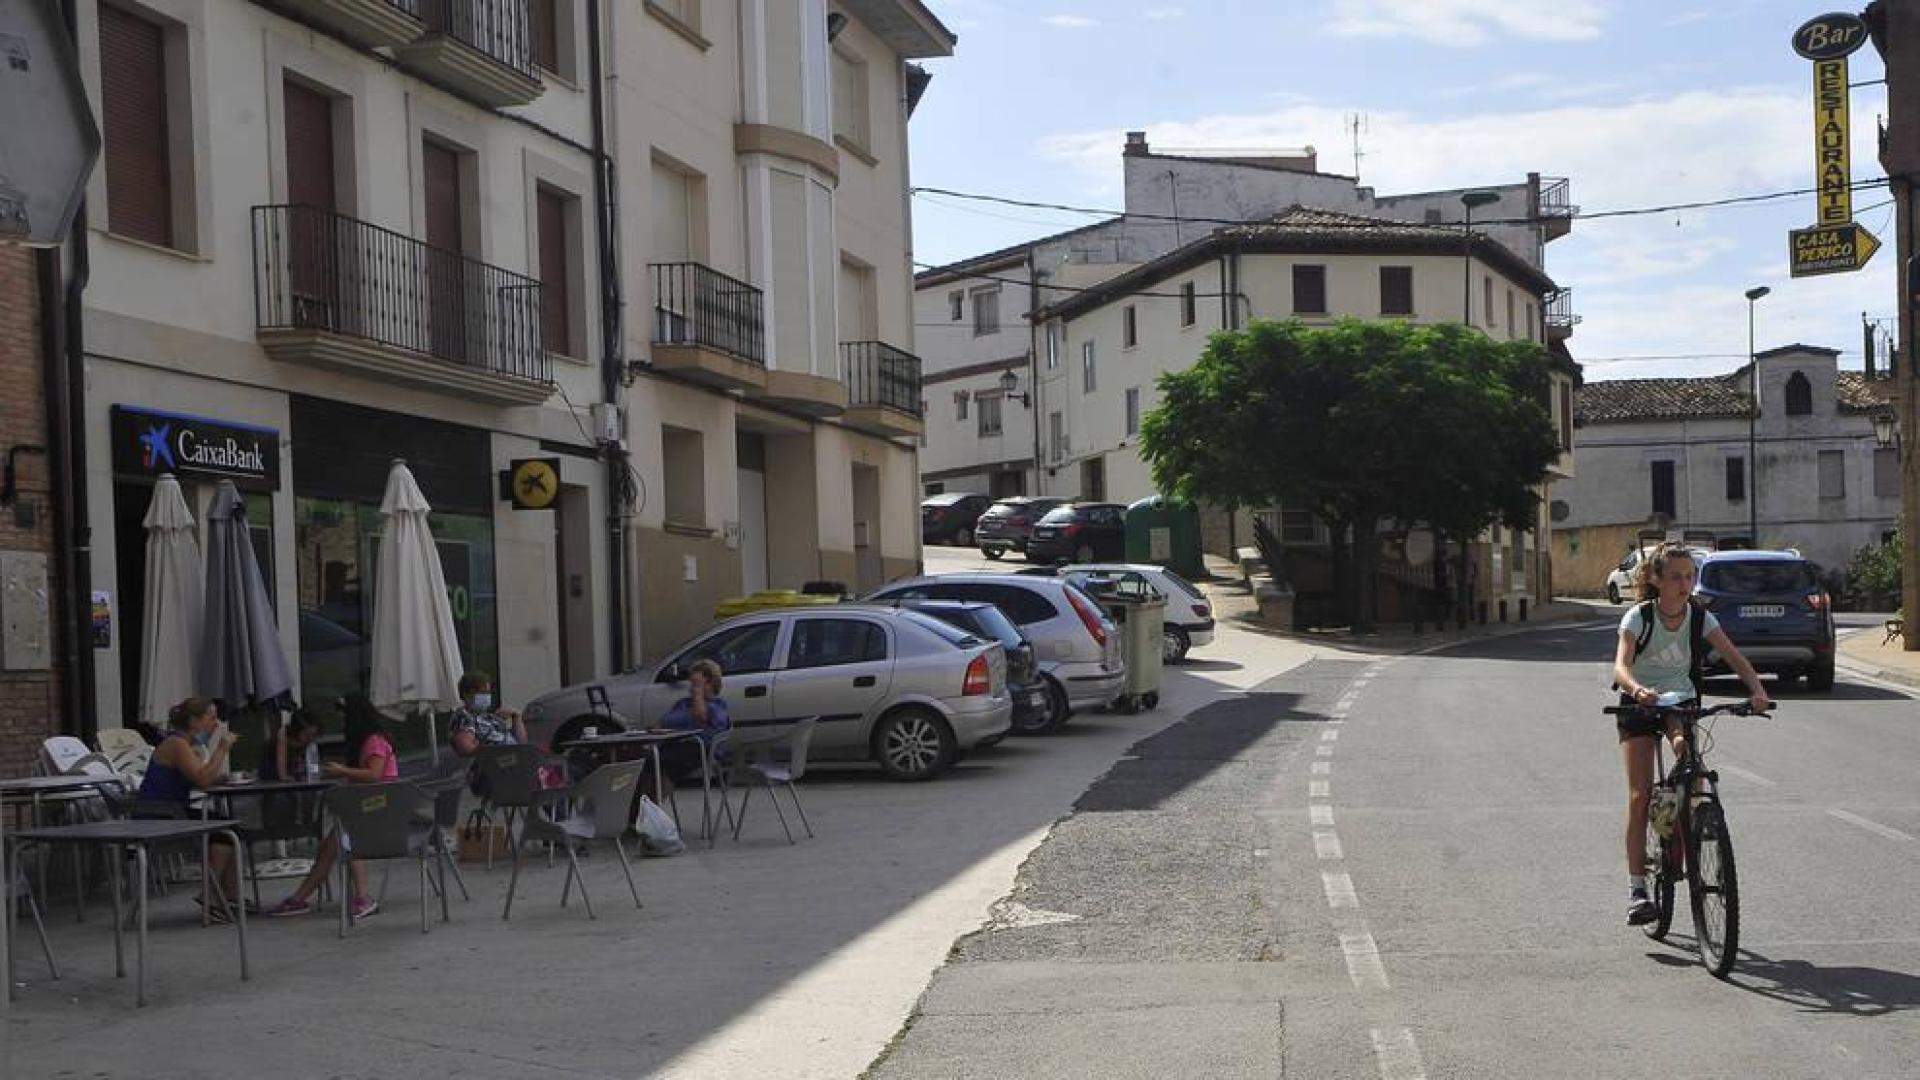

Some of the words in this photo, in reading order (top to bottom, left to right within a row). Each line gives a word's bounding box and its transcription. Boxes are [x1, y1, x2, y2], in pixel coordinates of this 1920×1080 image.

[1802, 23, 1859, 52] Bar
[1819, 63, 1844, 219] RESTAURANTE
[1798, 232, 1839, 249] CASA
[178, 429, 265, 470] CaixaBank
